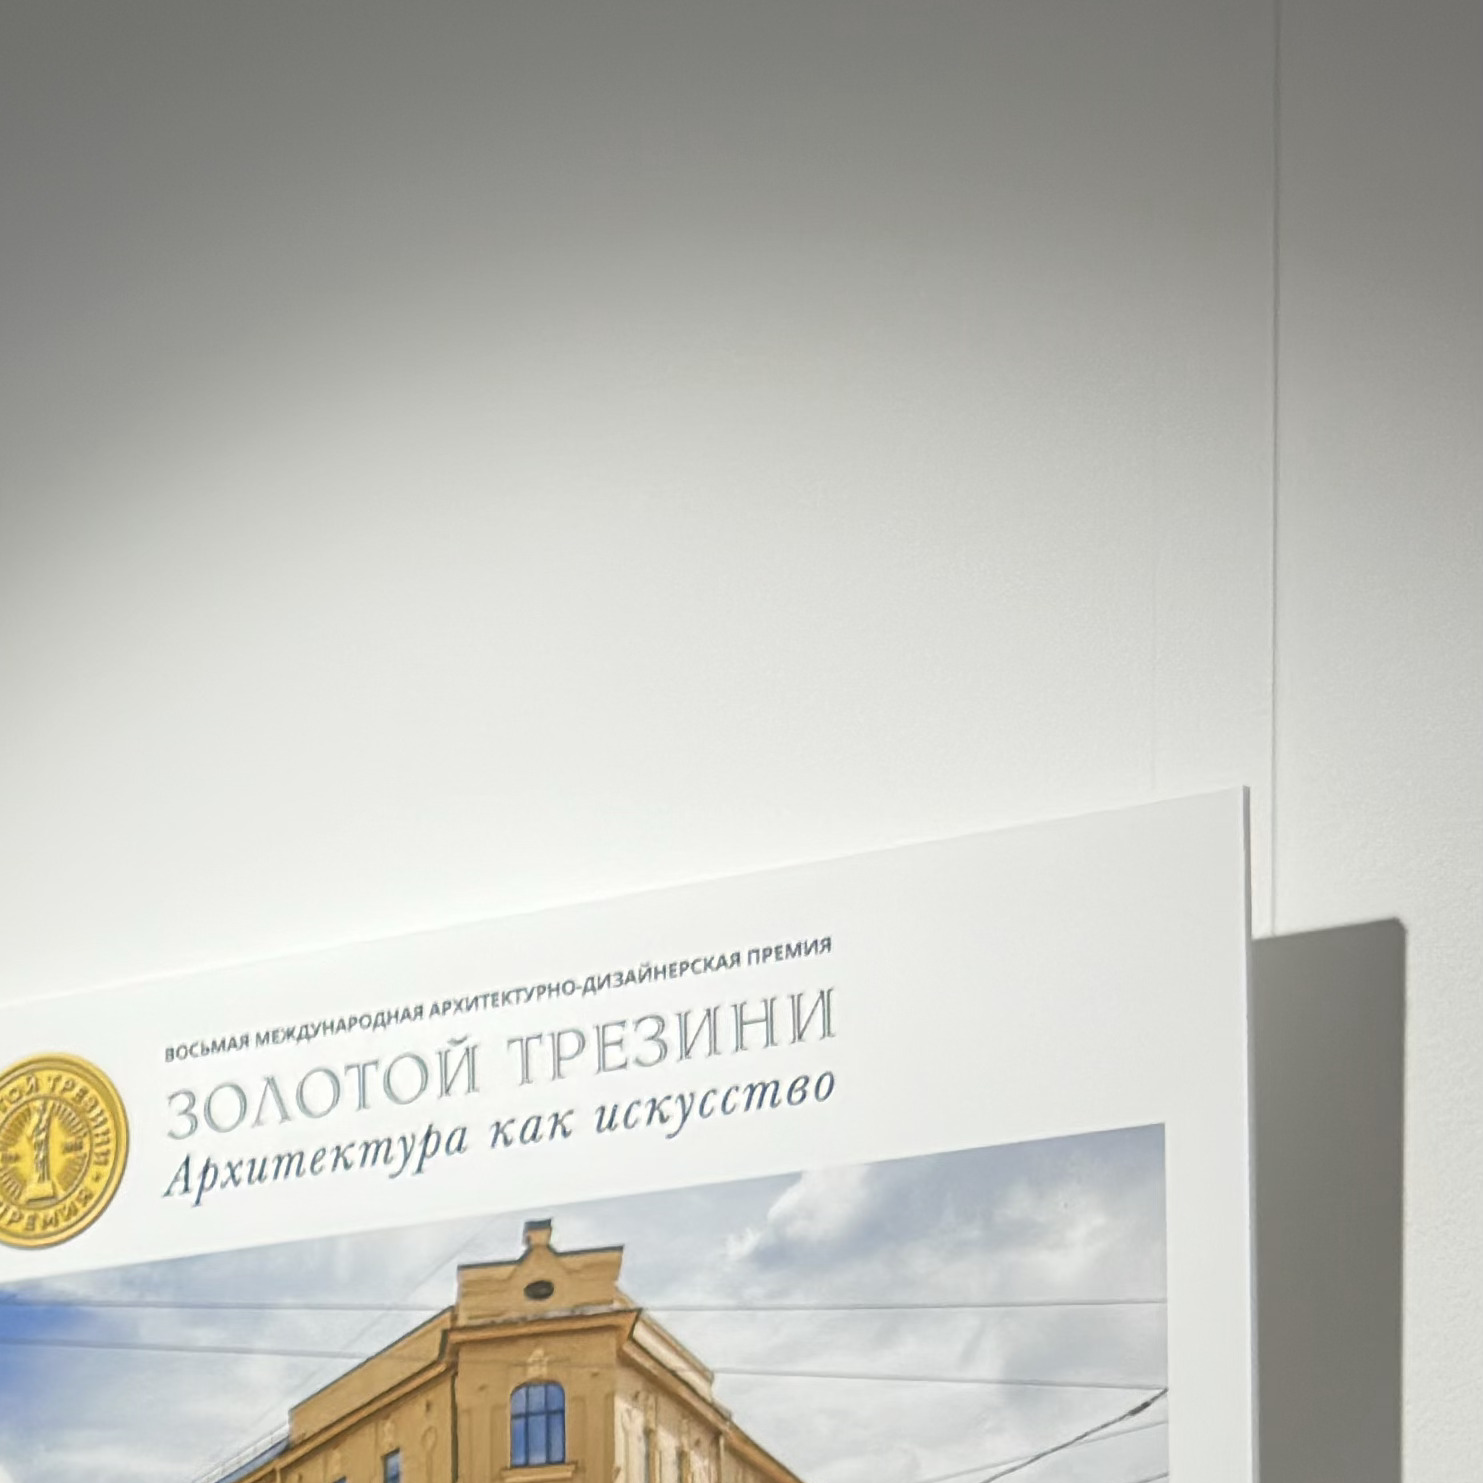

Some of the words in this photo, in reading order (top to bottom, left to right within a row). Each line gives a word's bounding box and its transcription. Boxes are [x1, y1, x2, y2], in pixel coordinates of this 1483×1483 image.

[164, 1033, 250, 1062] ВОСЬМАЯ
[254, 1004, 424, 1047] МЕЖДУНАРОДНАЯ
[428, 950, 742, 1018] АРХИТЕКТУРНО-ДИЗАЙНЕРСКАЯ
[746, 935, 833, 965] ПРЕМИЯ
[166, 1033, 479, 1141] ЗОЛОТОЙ
[506, 986, 838, 1088] ТРЕЗИНИ
[165, 1125, 467, 1206] Архитектура
[490, 1109, 574, 1148] как
[594, 1071, 834, 1135] искусство
